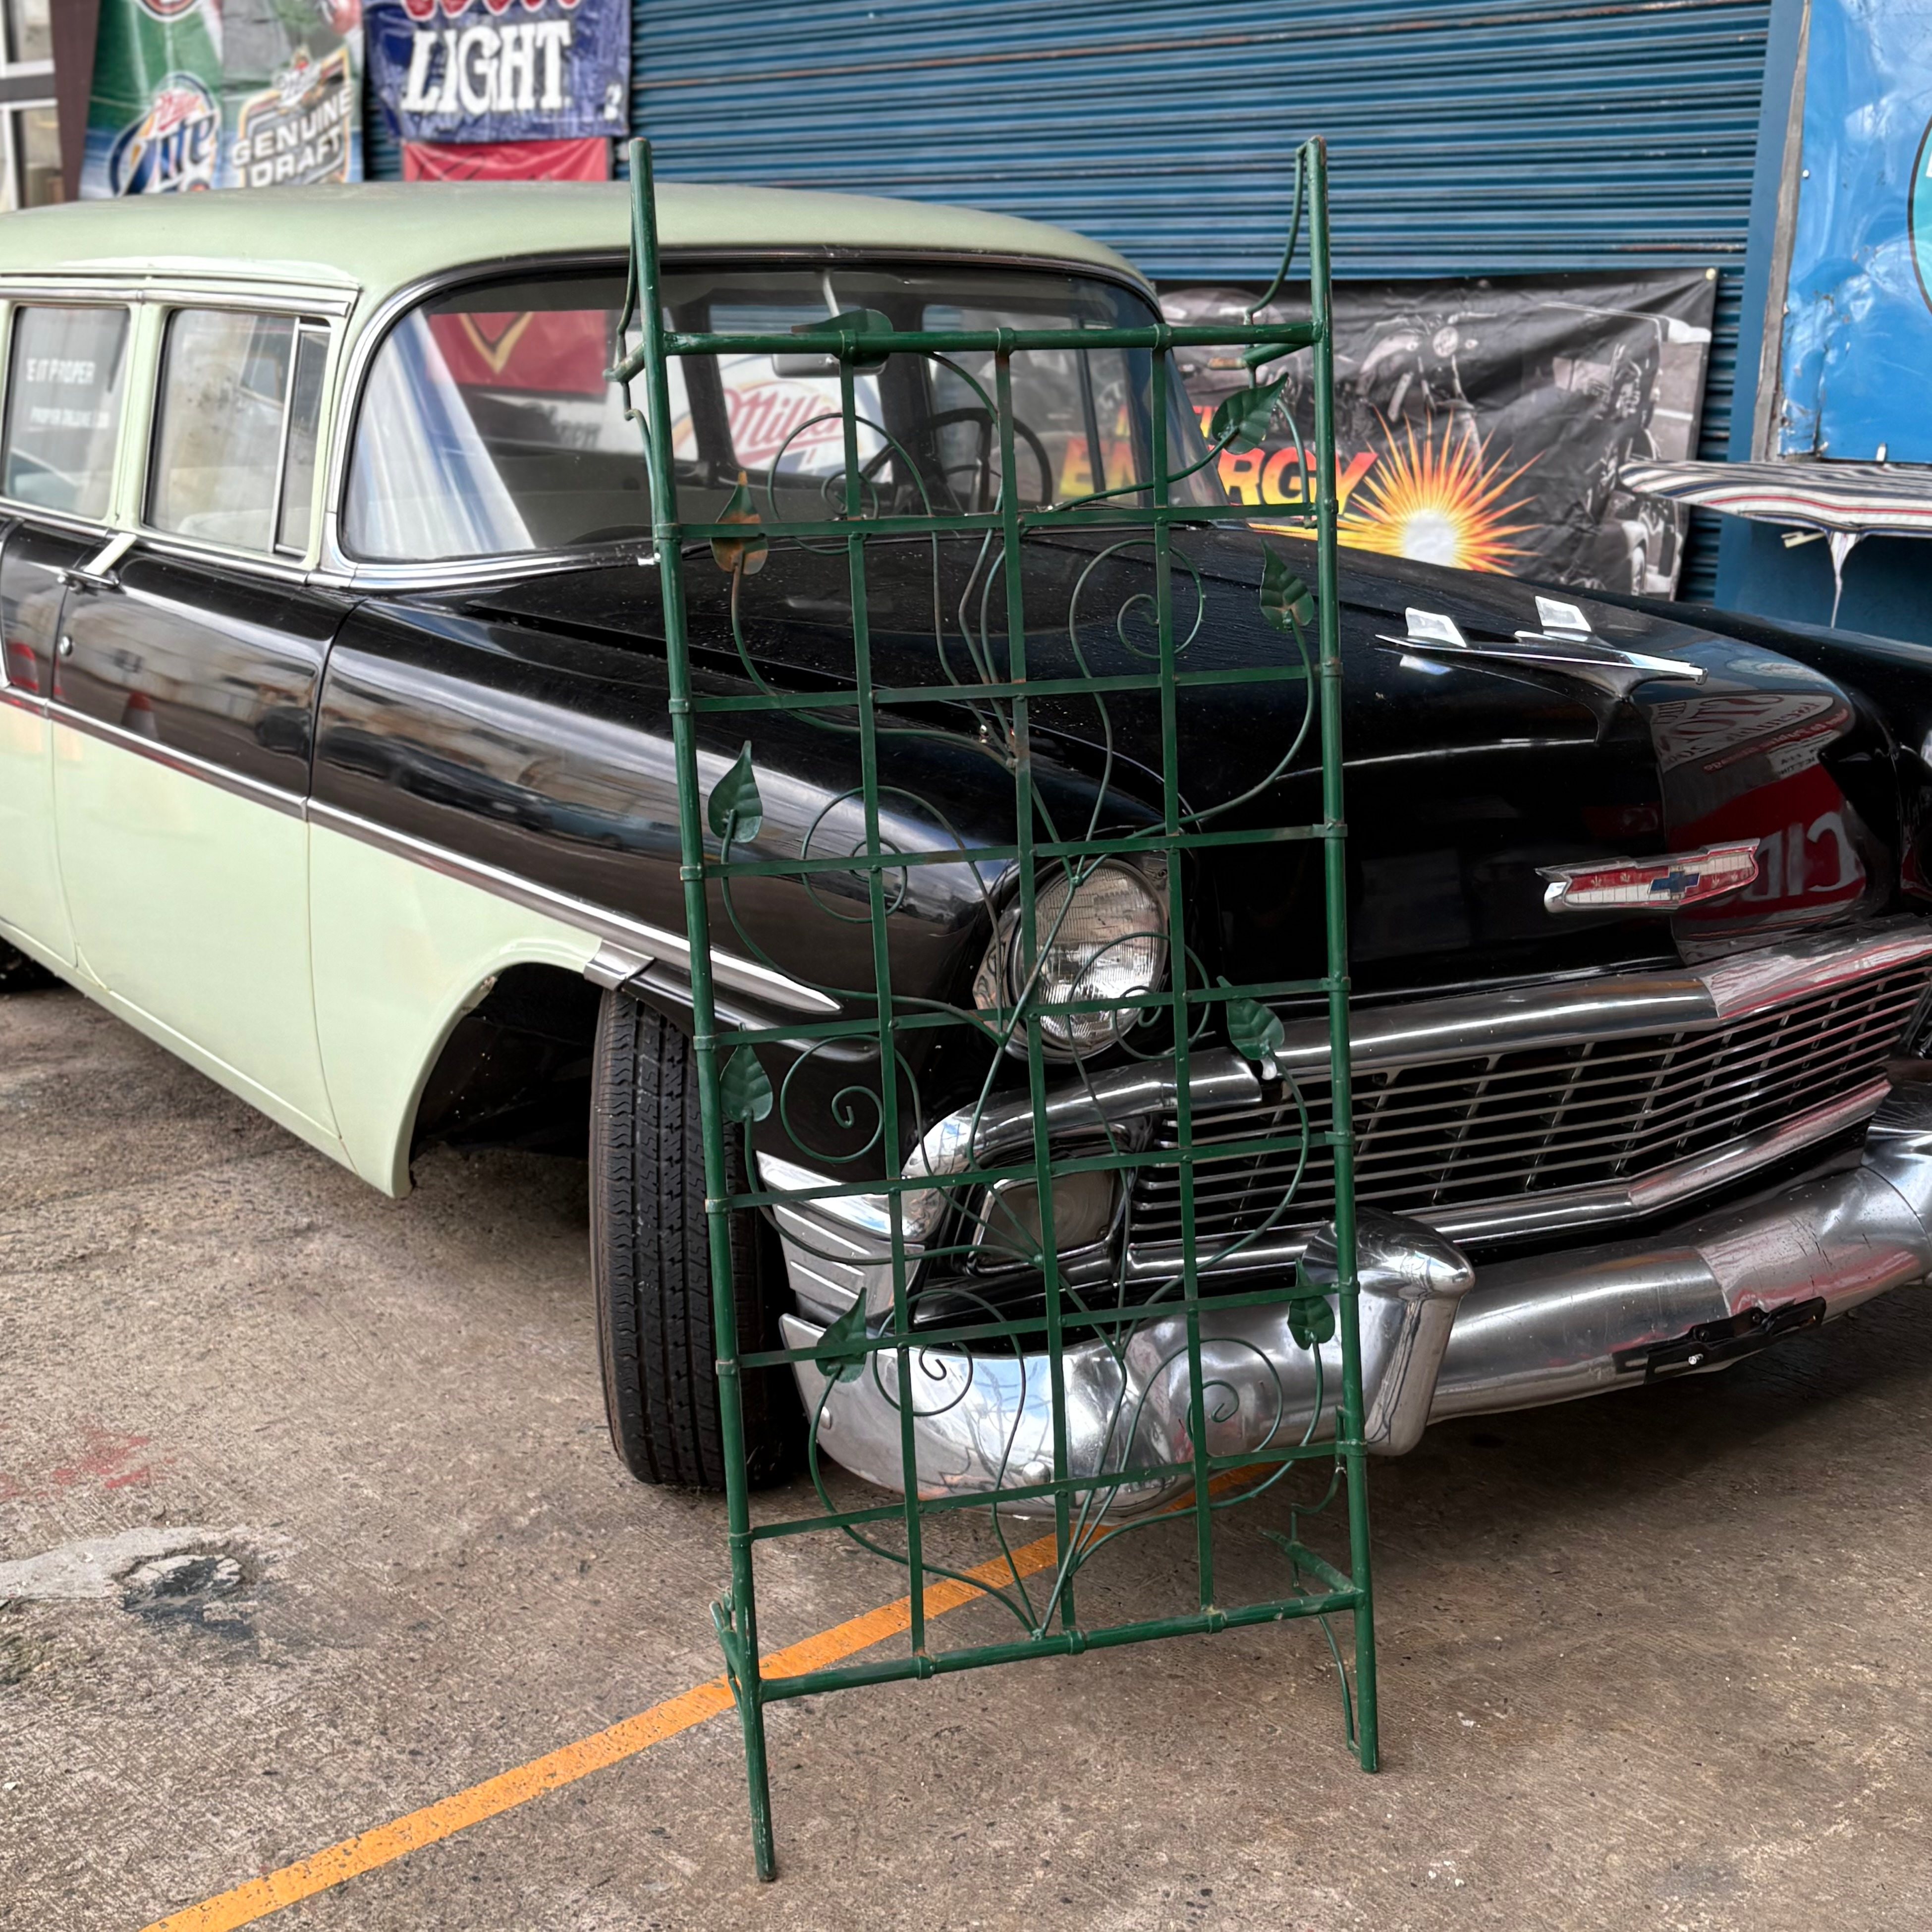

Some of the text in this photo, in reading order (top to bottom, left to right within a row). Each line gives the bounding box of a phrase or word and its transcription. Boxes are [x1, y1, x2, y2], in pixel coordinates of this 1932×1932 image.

[400, 20, 572, 115] LIGHT
[232, 84, 353, 167] GENUINE
[249, 125, 343, 187] DRAFT
[1059, 436, 1379, 515] ENRGY
